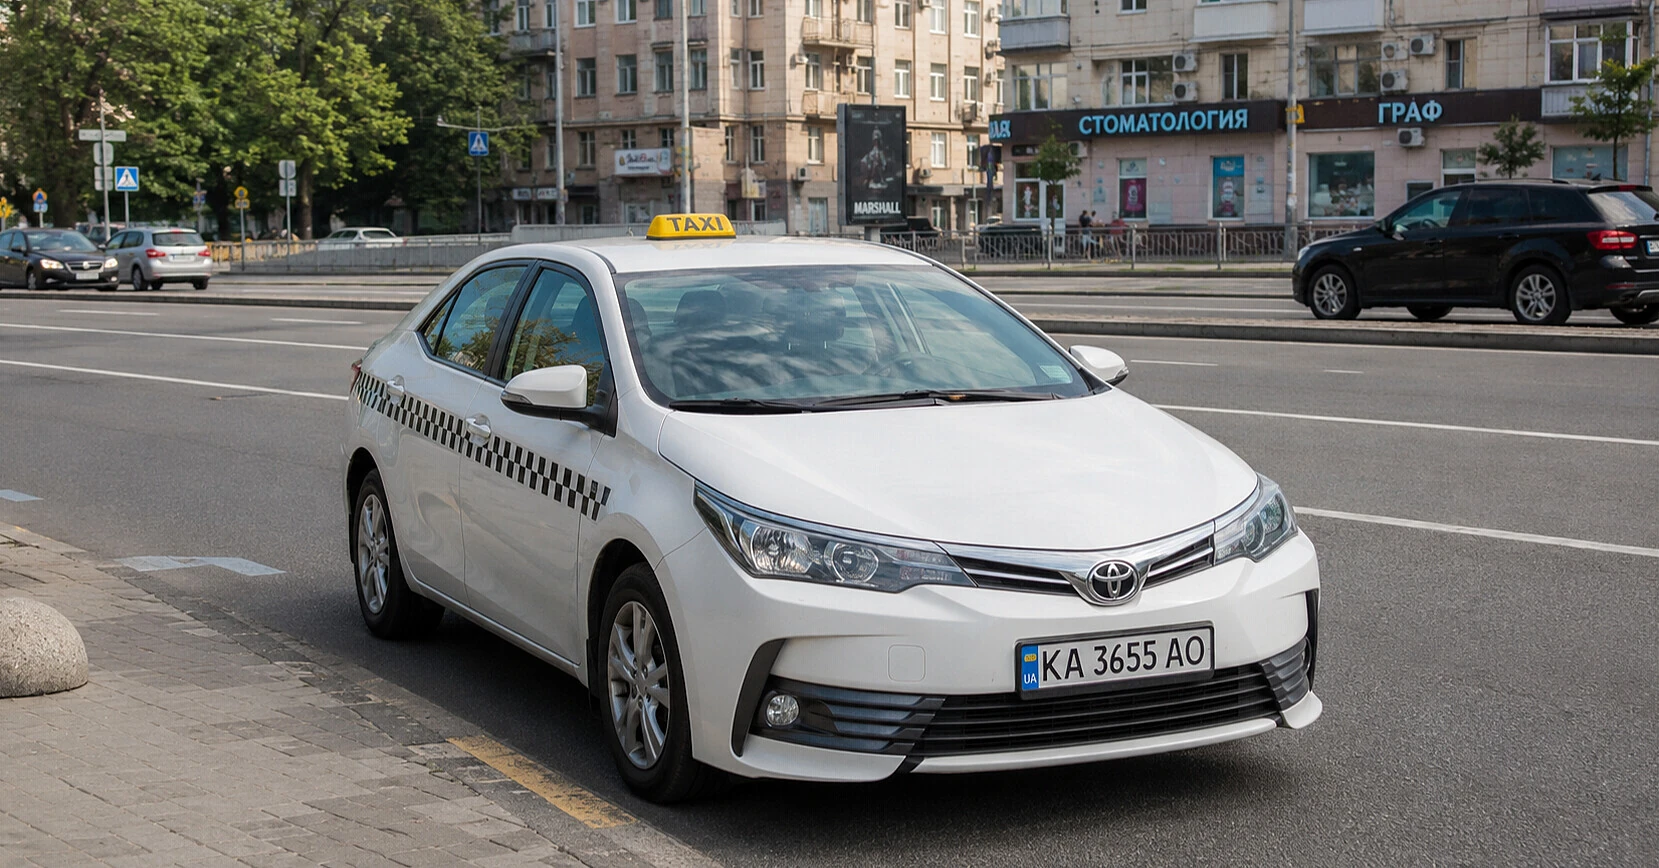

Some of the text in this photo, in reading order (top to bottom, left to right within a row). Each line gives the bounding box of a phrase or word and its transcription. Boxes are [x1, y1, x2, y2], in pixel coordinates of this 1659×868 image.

[1078, 108, 1249, 135] СТОМАТОЛОГИЯ
[1378, 99, 1443, 124] ГРАФ
[853, 201, 901, 214] MARSHALL
[666, 216, 724, 232] TAXI
[1042, 635, 1205, 682] KA 3655 AO
[1023, 673, 1037, 685] UA
